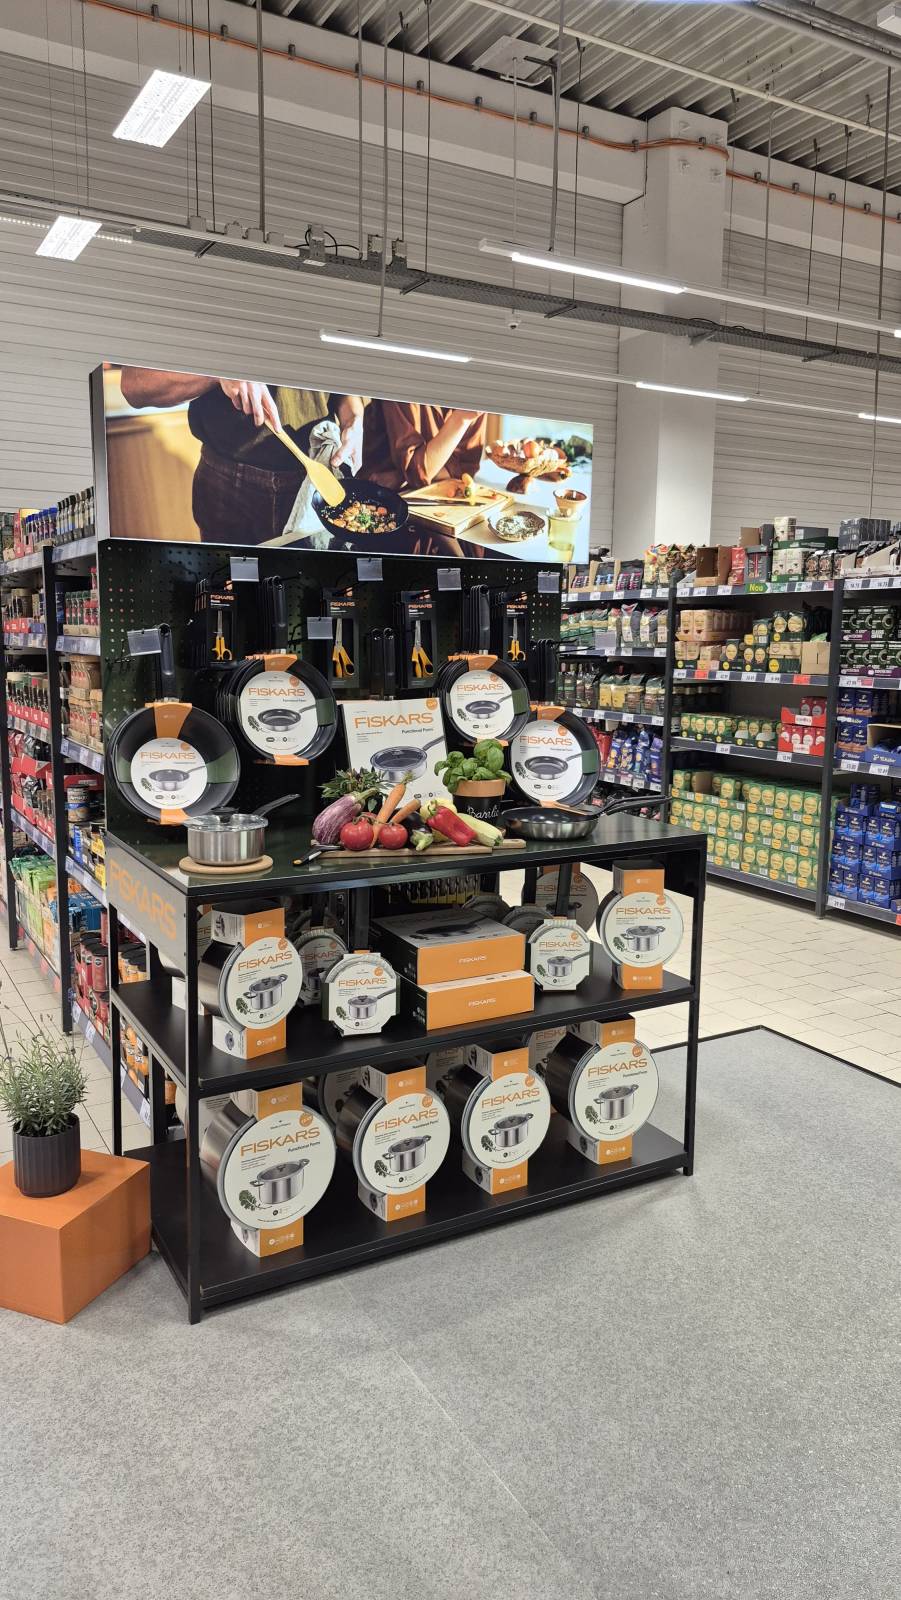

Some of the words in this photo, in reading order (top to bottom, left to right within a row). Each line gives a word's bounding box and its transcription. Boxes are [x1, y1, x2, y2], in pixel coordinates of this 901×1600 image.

[248, 687, 306, 697] FISKARS
[457, 684, 504, 692] FISKARS
[354, 712, 434, 729] FISKARS
[519, 735, 573, 746] FISKARS
[140, 751, 197, 760] FISKARS
[109, 859, 177, 941] FISKARS
[615, 907, 672, 916] FISKARS
[539, 941, 583, 949] FISKARS
[237, 950, 294, 972] FISKARS
[459, 955, 487, 964] FISKARS
[338, 977, 388, 988] FISKARS
[468, 998, 497, 1007] FISKARS
[587, 1058, 648, 1079] FISKARS
[481, 1087, 541, 1110] FISKARS
[374, 1108, 439, 1133] FISKARS
[240, 1127, 321, 1157] FISKARS
